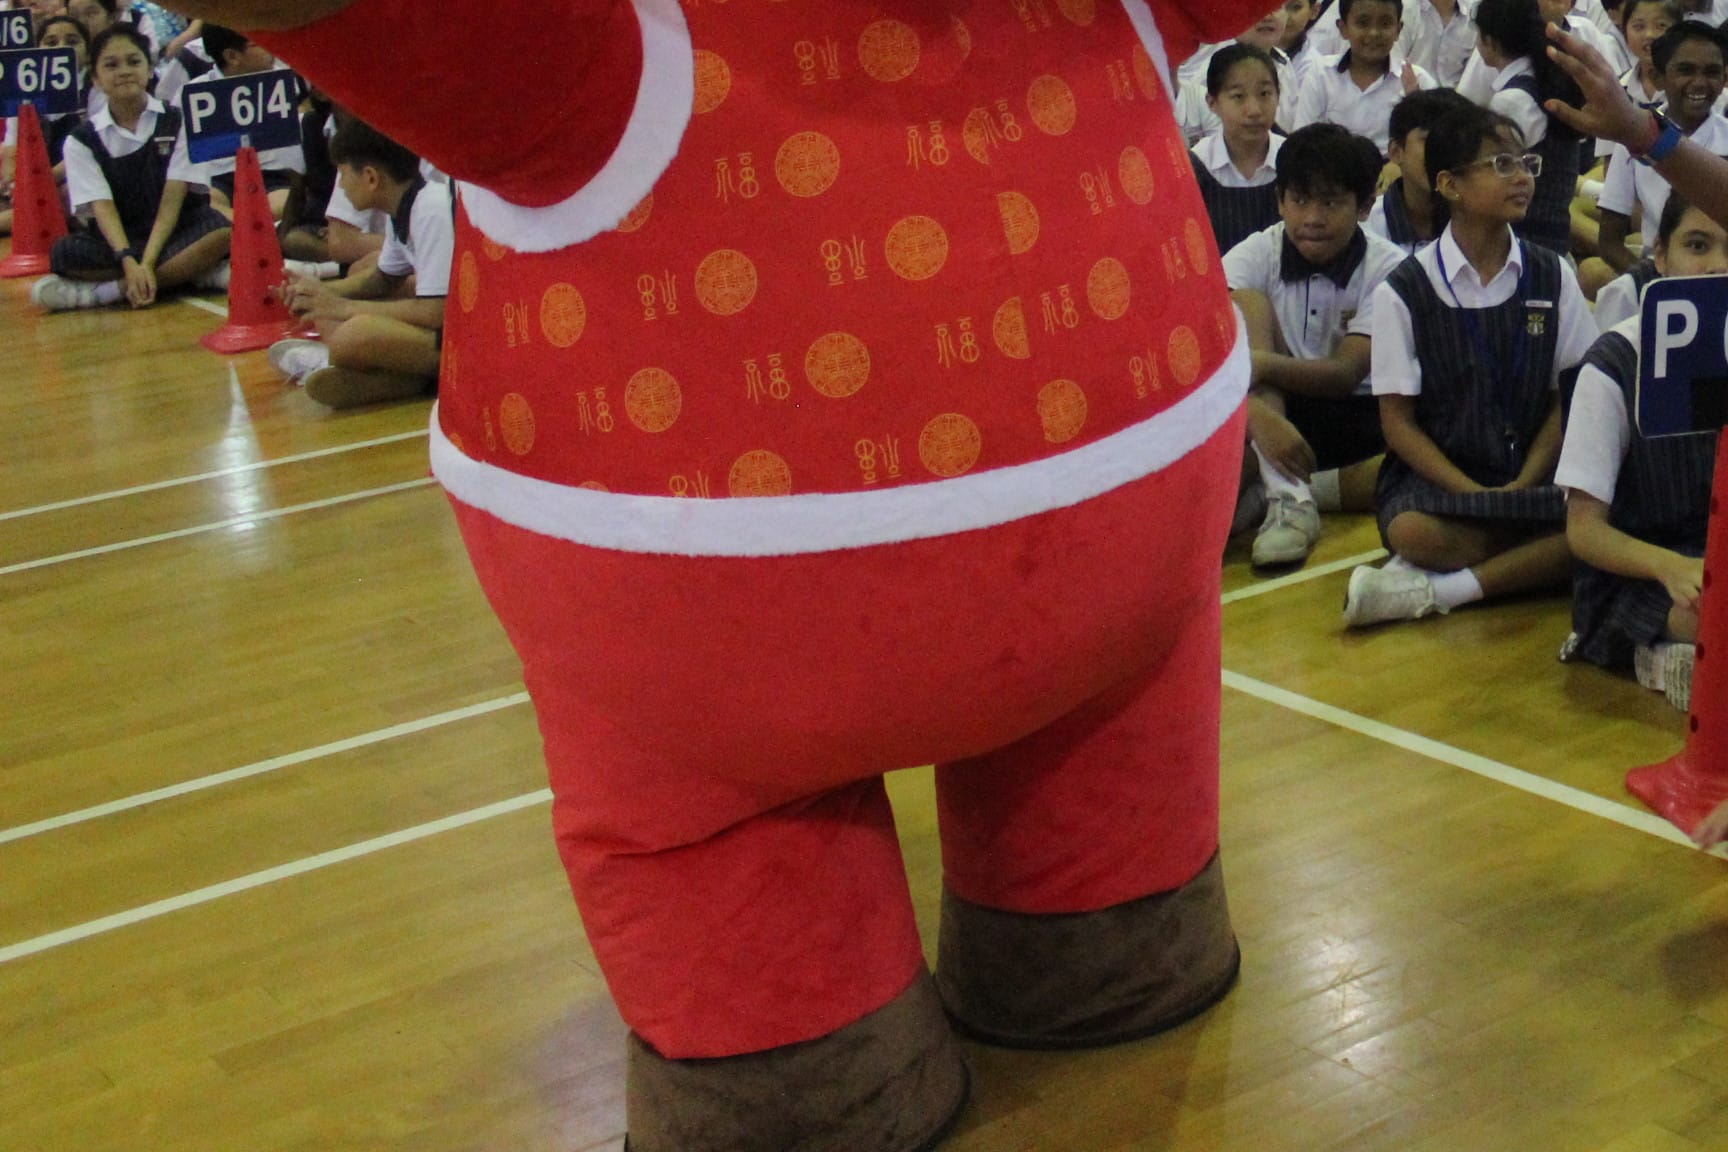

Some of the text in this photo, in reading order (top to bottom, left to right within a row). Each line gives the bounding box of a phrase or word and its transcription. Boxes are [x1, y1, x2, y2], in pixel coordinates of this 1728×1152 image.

[0, 15, 29, 46] /6
[17, 55, 72, 93] 6/5
[188, 79, 291, 133] P 6/4
[1653, 299, 1699, 379] P
